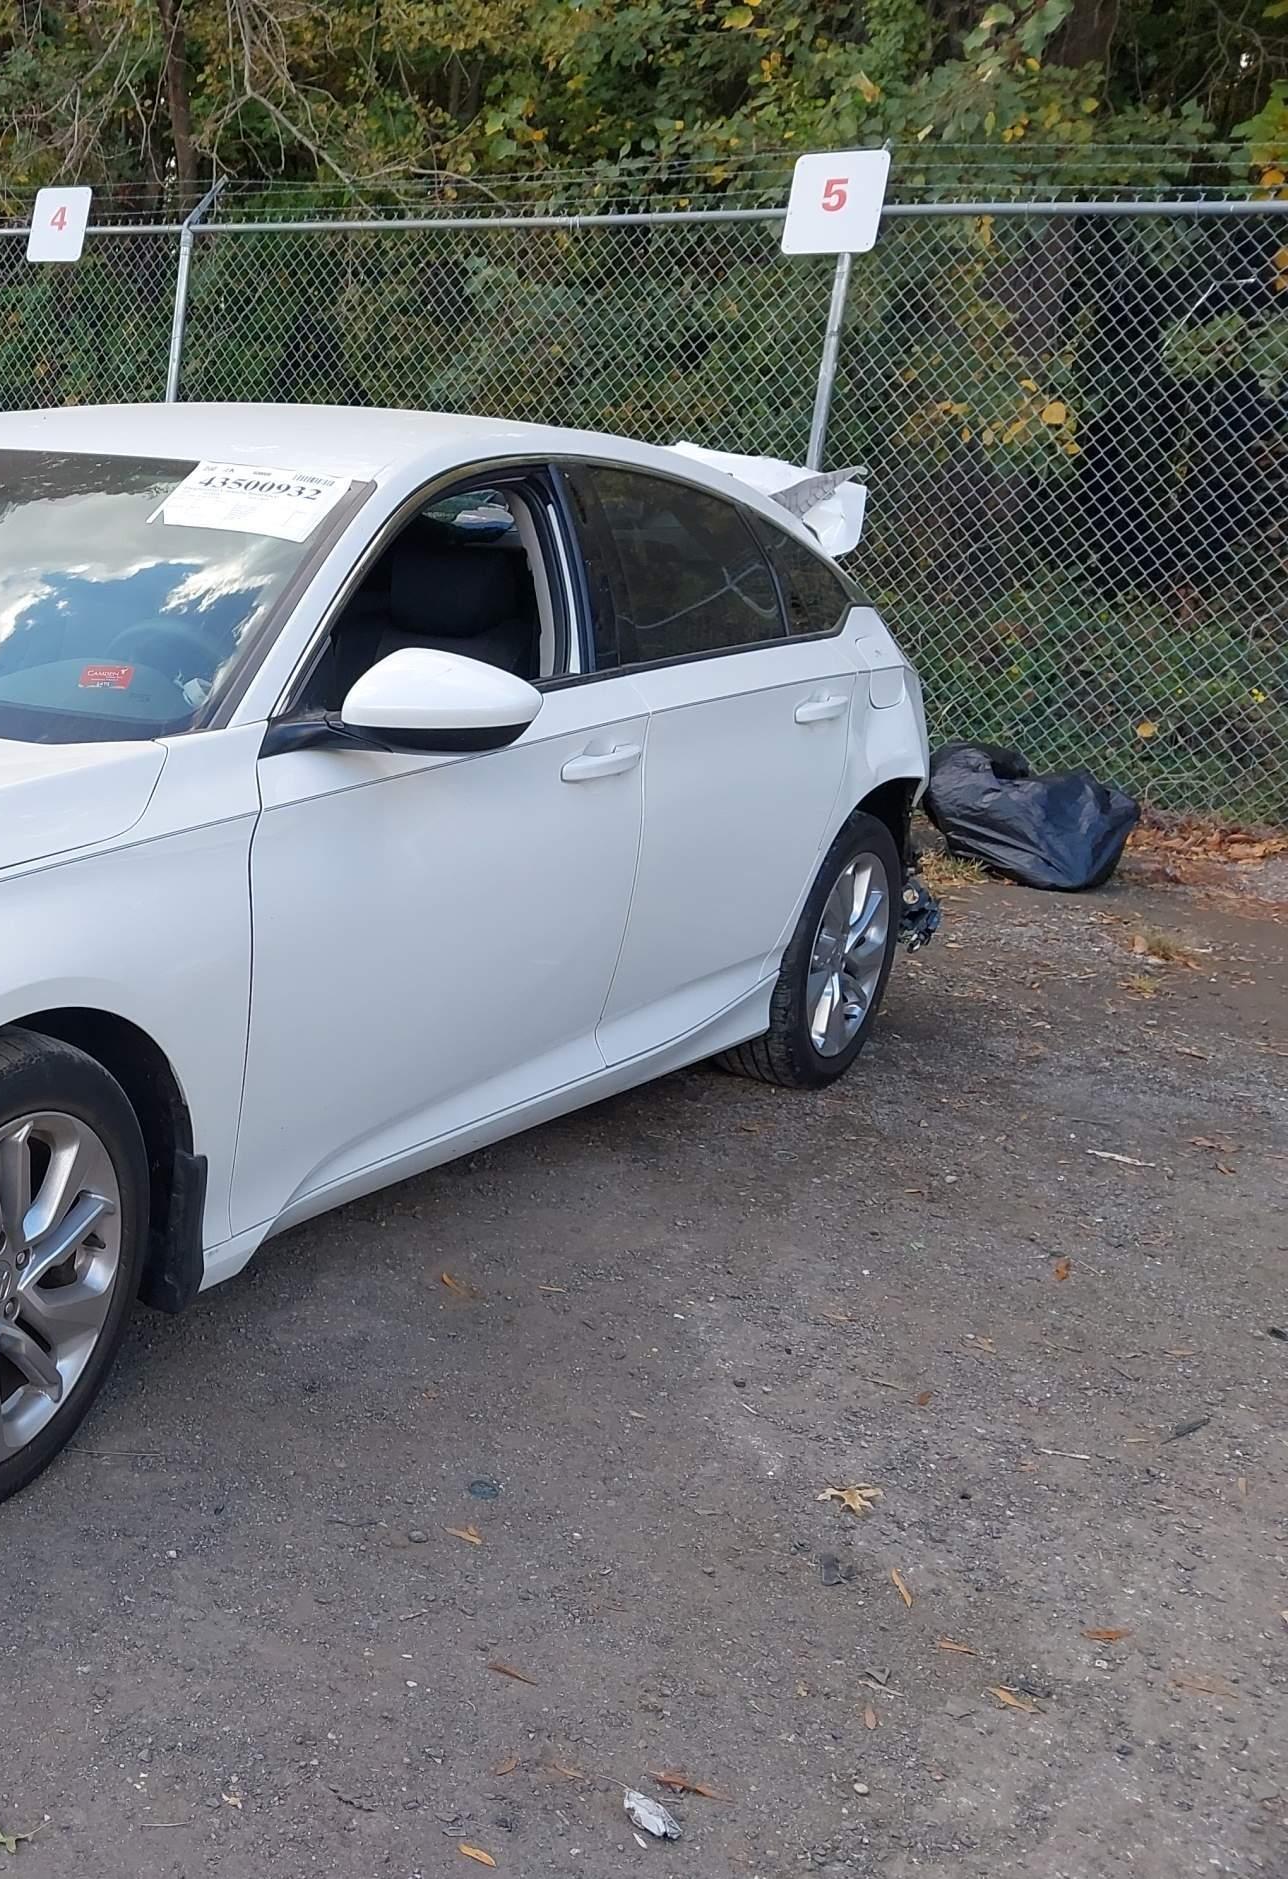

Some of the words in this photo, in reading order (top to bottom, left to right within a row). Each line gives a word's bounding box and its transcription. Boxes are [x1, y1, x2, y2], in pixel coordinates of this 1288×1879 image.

[822, 178, 849, 212] 5
[50, 206, 67, 231] 4
[198, 475, 323, 501] 43500932
